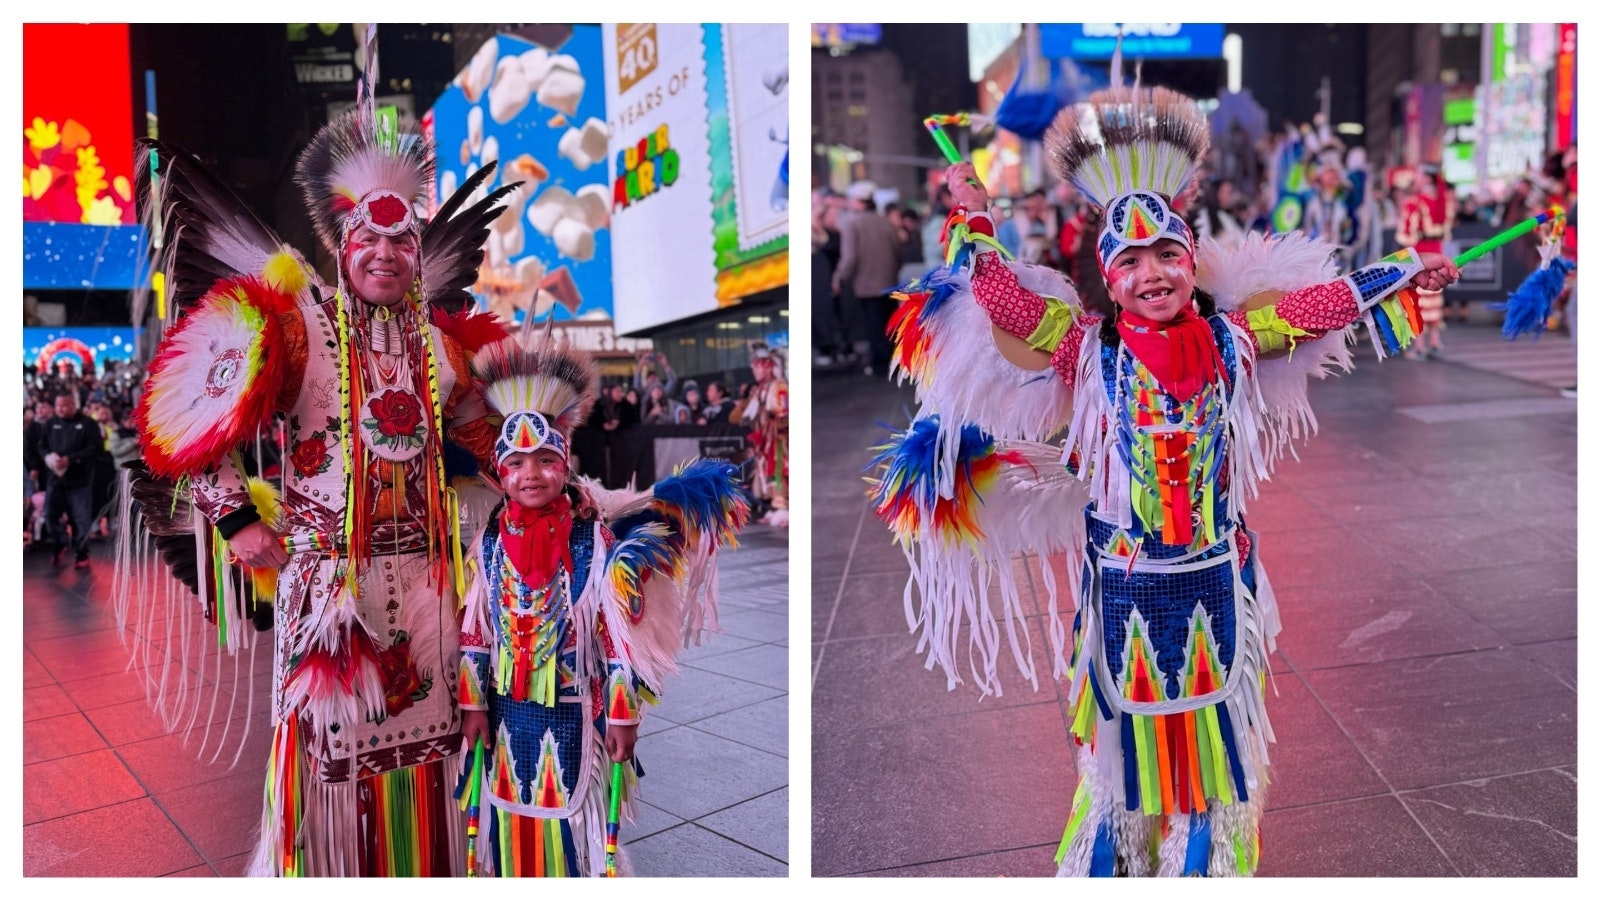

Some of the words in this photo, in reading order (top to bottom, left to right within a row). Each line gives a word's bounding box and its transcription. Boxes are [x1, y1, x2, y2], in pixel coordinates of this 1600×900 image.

[294, 63, 354, 83] WICKED
[620, 35, 656, 80] 40
[619, 85, 663, 132] YEARS
[668, 65, 689, 96] OF
[616, 123, 669, 177] SUPER
[612, 148, 680, 213] MARIO
